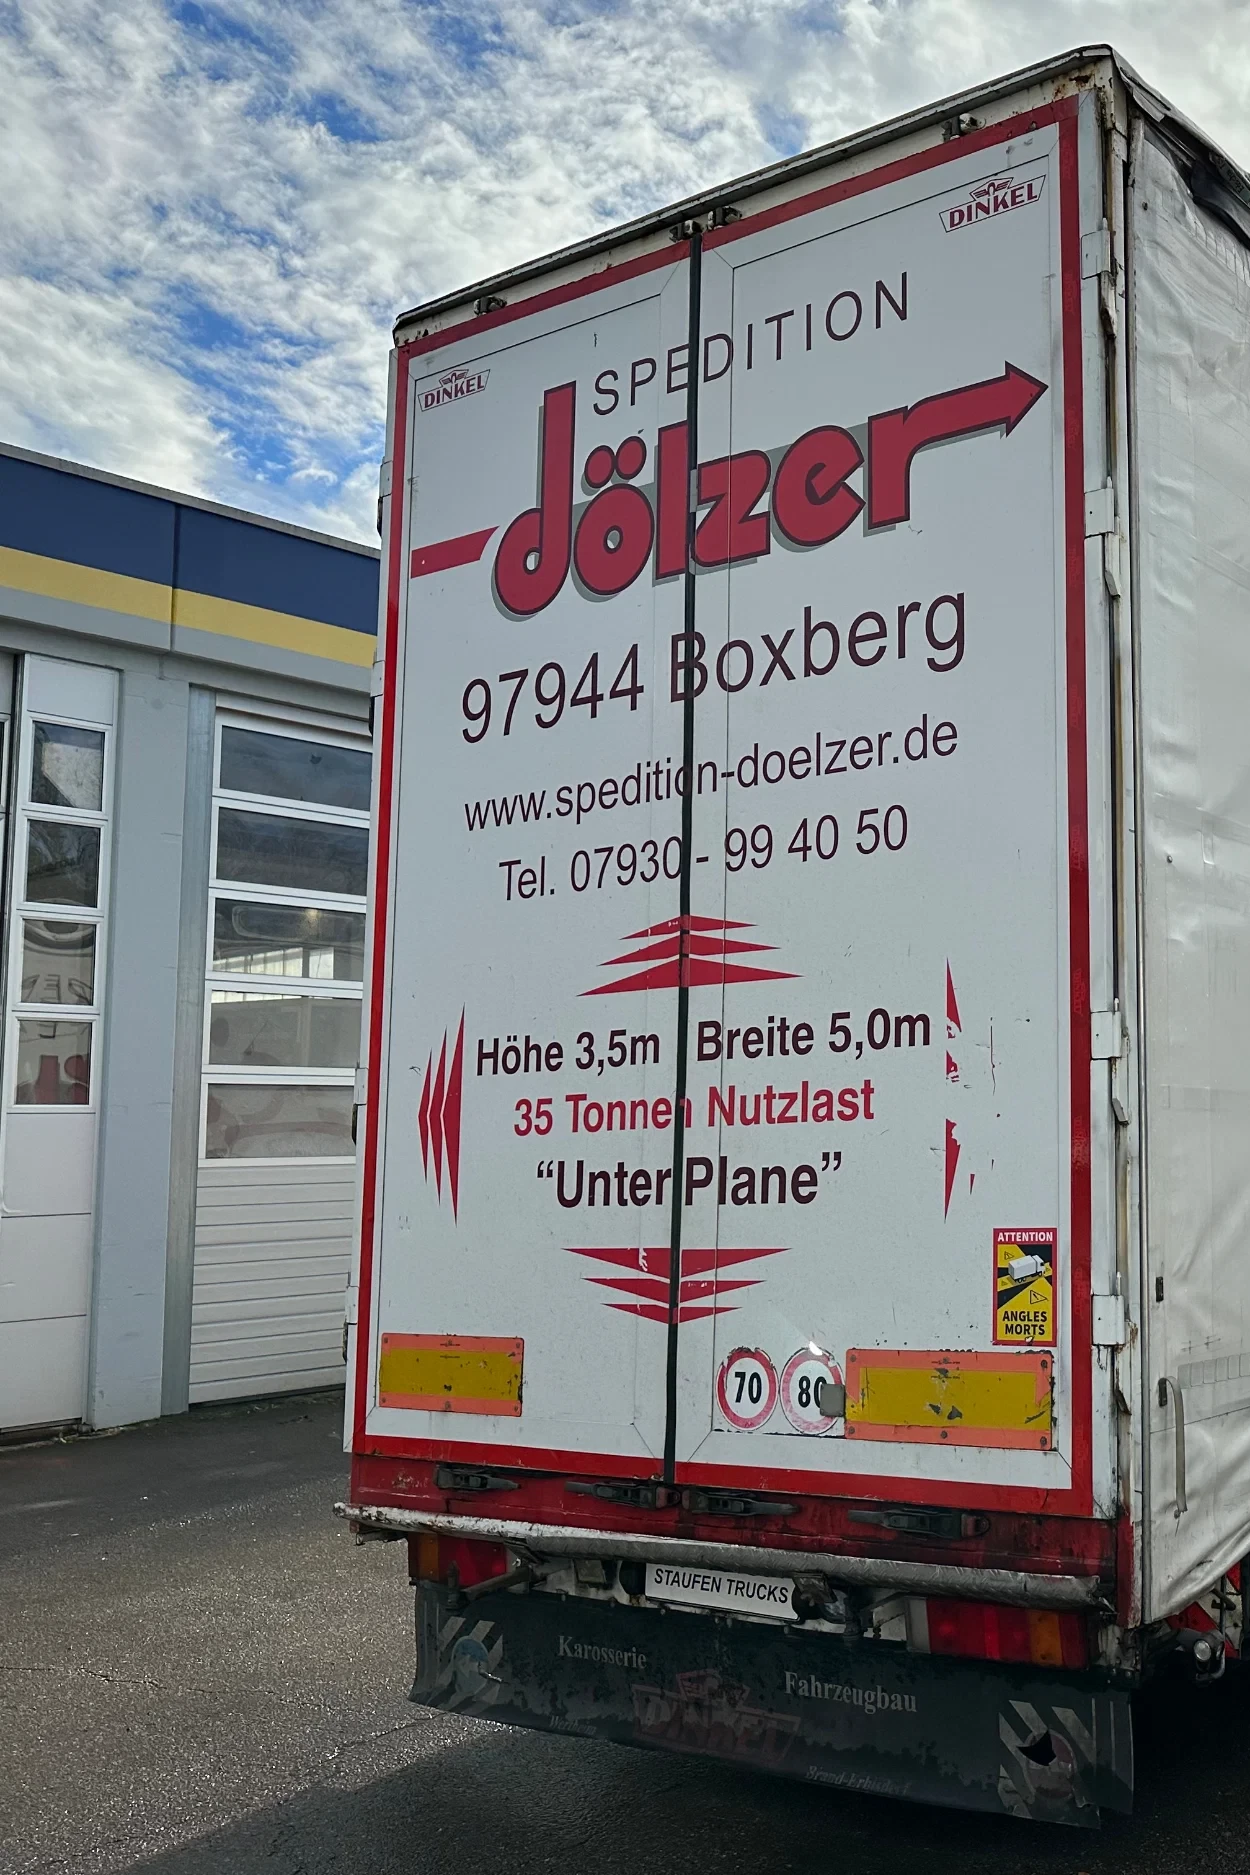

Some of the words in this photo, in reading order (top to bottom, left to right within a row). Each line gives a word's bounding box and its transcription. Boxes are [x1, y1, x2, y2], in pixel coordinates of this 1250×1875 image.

[949, 182, 1038, 229] DINKEL
[593, 271, 907, 416] SPEDITION
[424, 374, 485, 409] DINKEL
[494, 381, 950, 616] dölzer
[461, 644, 645, 743] 97944
[670, 591, 967, 703] Boxberg
[464, 714, 958, 831] www.spedition-doelzer.de
[499, 855, 556, 901] Tel.
[571, 836, 683, 892] 07930
[725, 824, 773, 872] 99
[787, 814, 839, 862] 40
[855, 804, 908, 854] 50
[476, 1033, 563, 1076] Höhe
[575, 1032, 660, 1076] 3,5m
[697, 1016, 815, 1061] Breite
[828, 1008, 931, 1056] 5,0m
[513, 1098, 553, 1136] 35
[565, 1093, 691, 1133] Tonnen
[708, 1079, 875, 1127] Nutzlast
[997, 1231, 1053, 1242] ATTENTION
[1002, 1310, 1048, 1323] ANGLES
[1004, 1323, 1046, 1336] MORTS
[734, 1371, 762, 1404] 70
[654, 1568, 722, 1593] STAUFEN
[727, 1578, 789, 1604] TRUCKS
[557, 1635, 647, 1670] Karosserie
[784, 1671, 918, 1715] Fahrzeugbau
